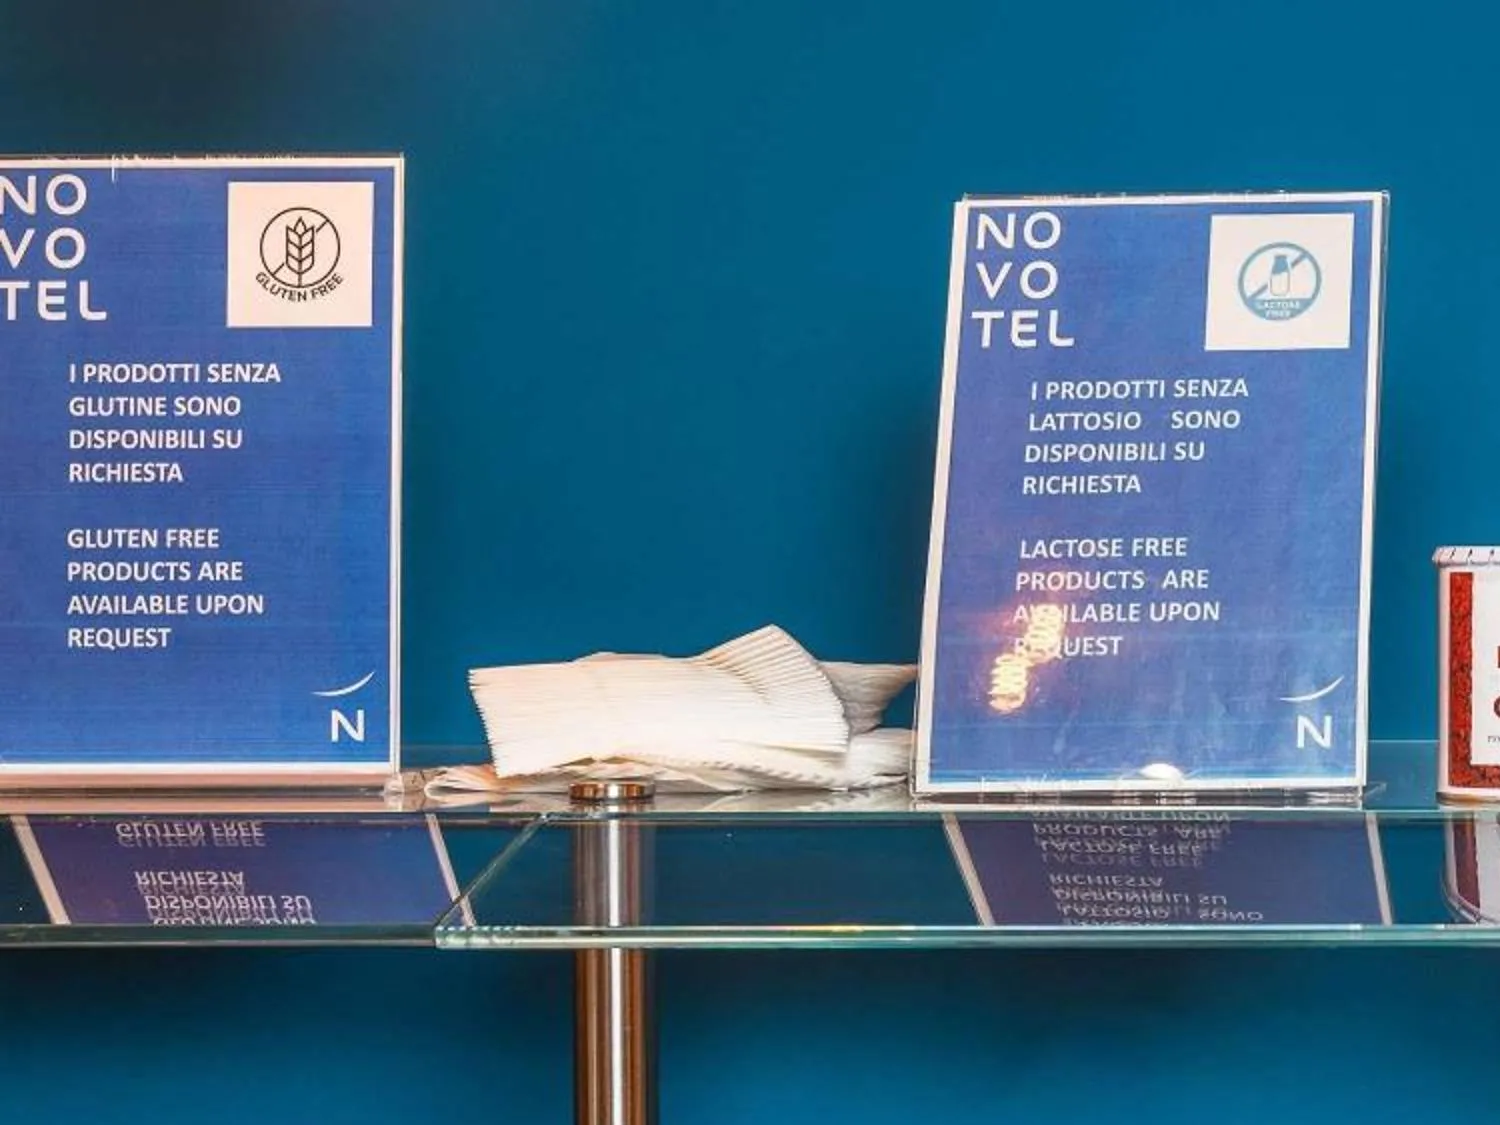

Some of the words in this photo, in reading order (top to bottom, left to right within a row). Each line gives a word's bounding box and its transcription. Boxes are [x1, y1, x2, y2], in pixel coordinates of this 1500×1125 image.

[0, 174, 86, 214] NO
[977, 212, 1060, 249] NO
[0, 228, 85, 268] VO
[255, 272, 307, 301] GLUTEN
[311, 273, 343, 298] FREE
[977, 261, 1057, 298] VO
[0, 281, 106, 320] TEL
[972, 310, 1073, 347] TEL
[70, 364, 75, 382] I
[84, 364, 199, 382] PRODOTTI
[208, 364, 280, 382] SENZA
[1032, 383, 1036, 400] I
[1046, 380, 1164, 399] PRODOTTI
[1174, 379, 1248, 397] SENZA
[70, 397, 166, 416] GLUTINE
[175, 396, 240, 416] SONO
[1030, 412, 1141, 431] LATTOSIO
[1172, 410, 1240, 428] SONO
[70, 430, 204, 448] DISPONIBILI
[213, 430, 242, 448] SU
[1025, 443, 1165, 462] DISPONIBILI
[1175, 442, 1204, 460] SU
[70, 463, 182, 482] RICHIESTA
[1023, 475, 1140, 494] RICHIESTA
[68, 529, 157, 548] GLUTEN
[167, 529, 218, 547] FREE
[1021, 539, 1122, 558] LACTOSE
[1133, 538, 1186, 556] FREE
[68, 562, 190, 581] PRODUCTS
[198, 562, 242, 580] ARE
[1015, 570, 1145, 591] PRODUCTS
[1162, 570, 1208, 588] ARE
[68, 595, 188, 614] AVAILABLE
[197, 595, 263, 614] UPON
[1150, 602, 1219, 621] UPON
[69, 628, 170, 650] REQUEST
[332, 710, 364, 741] N
[1298, 716, 1331, 747] N
